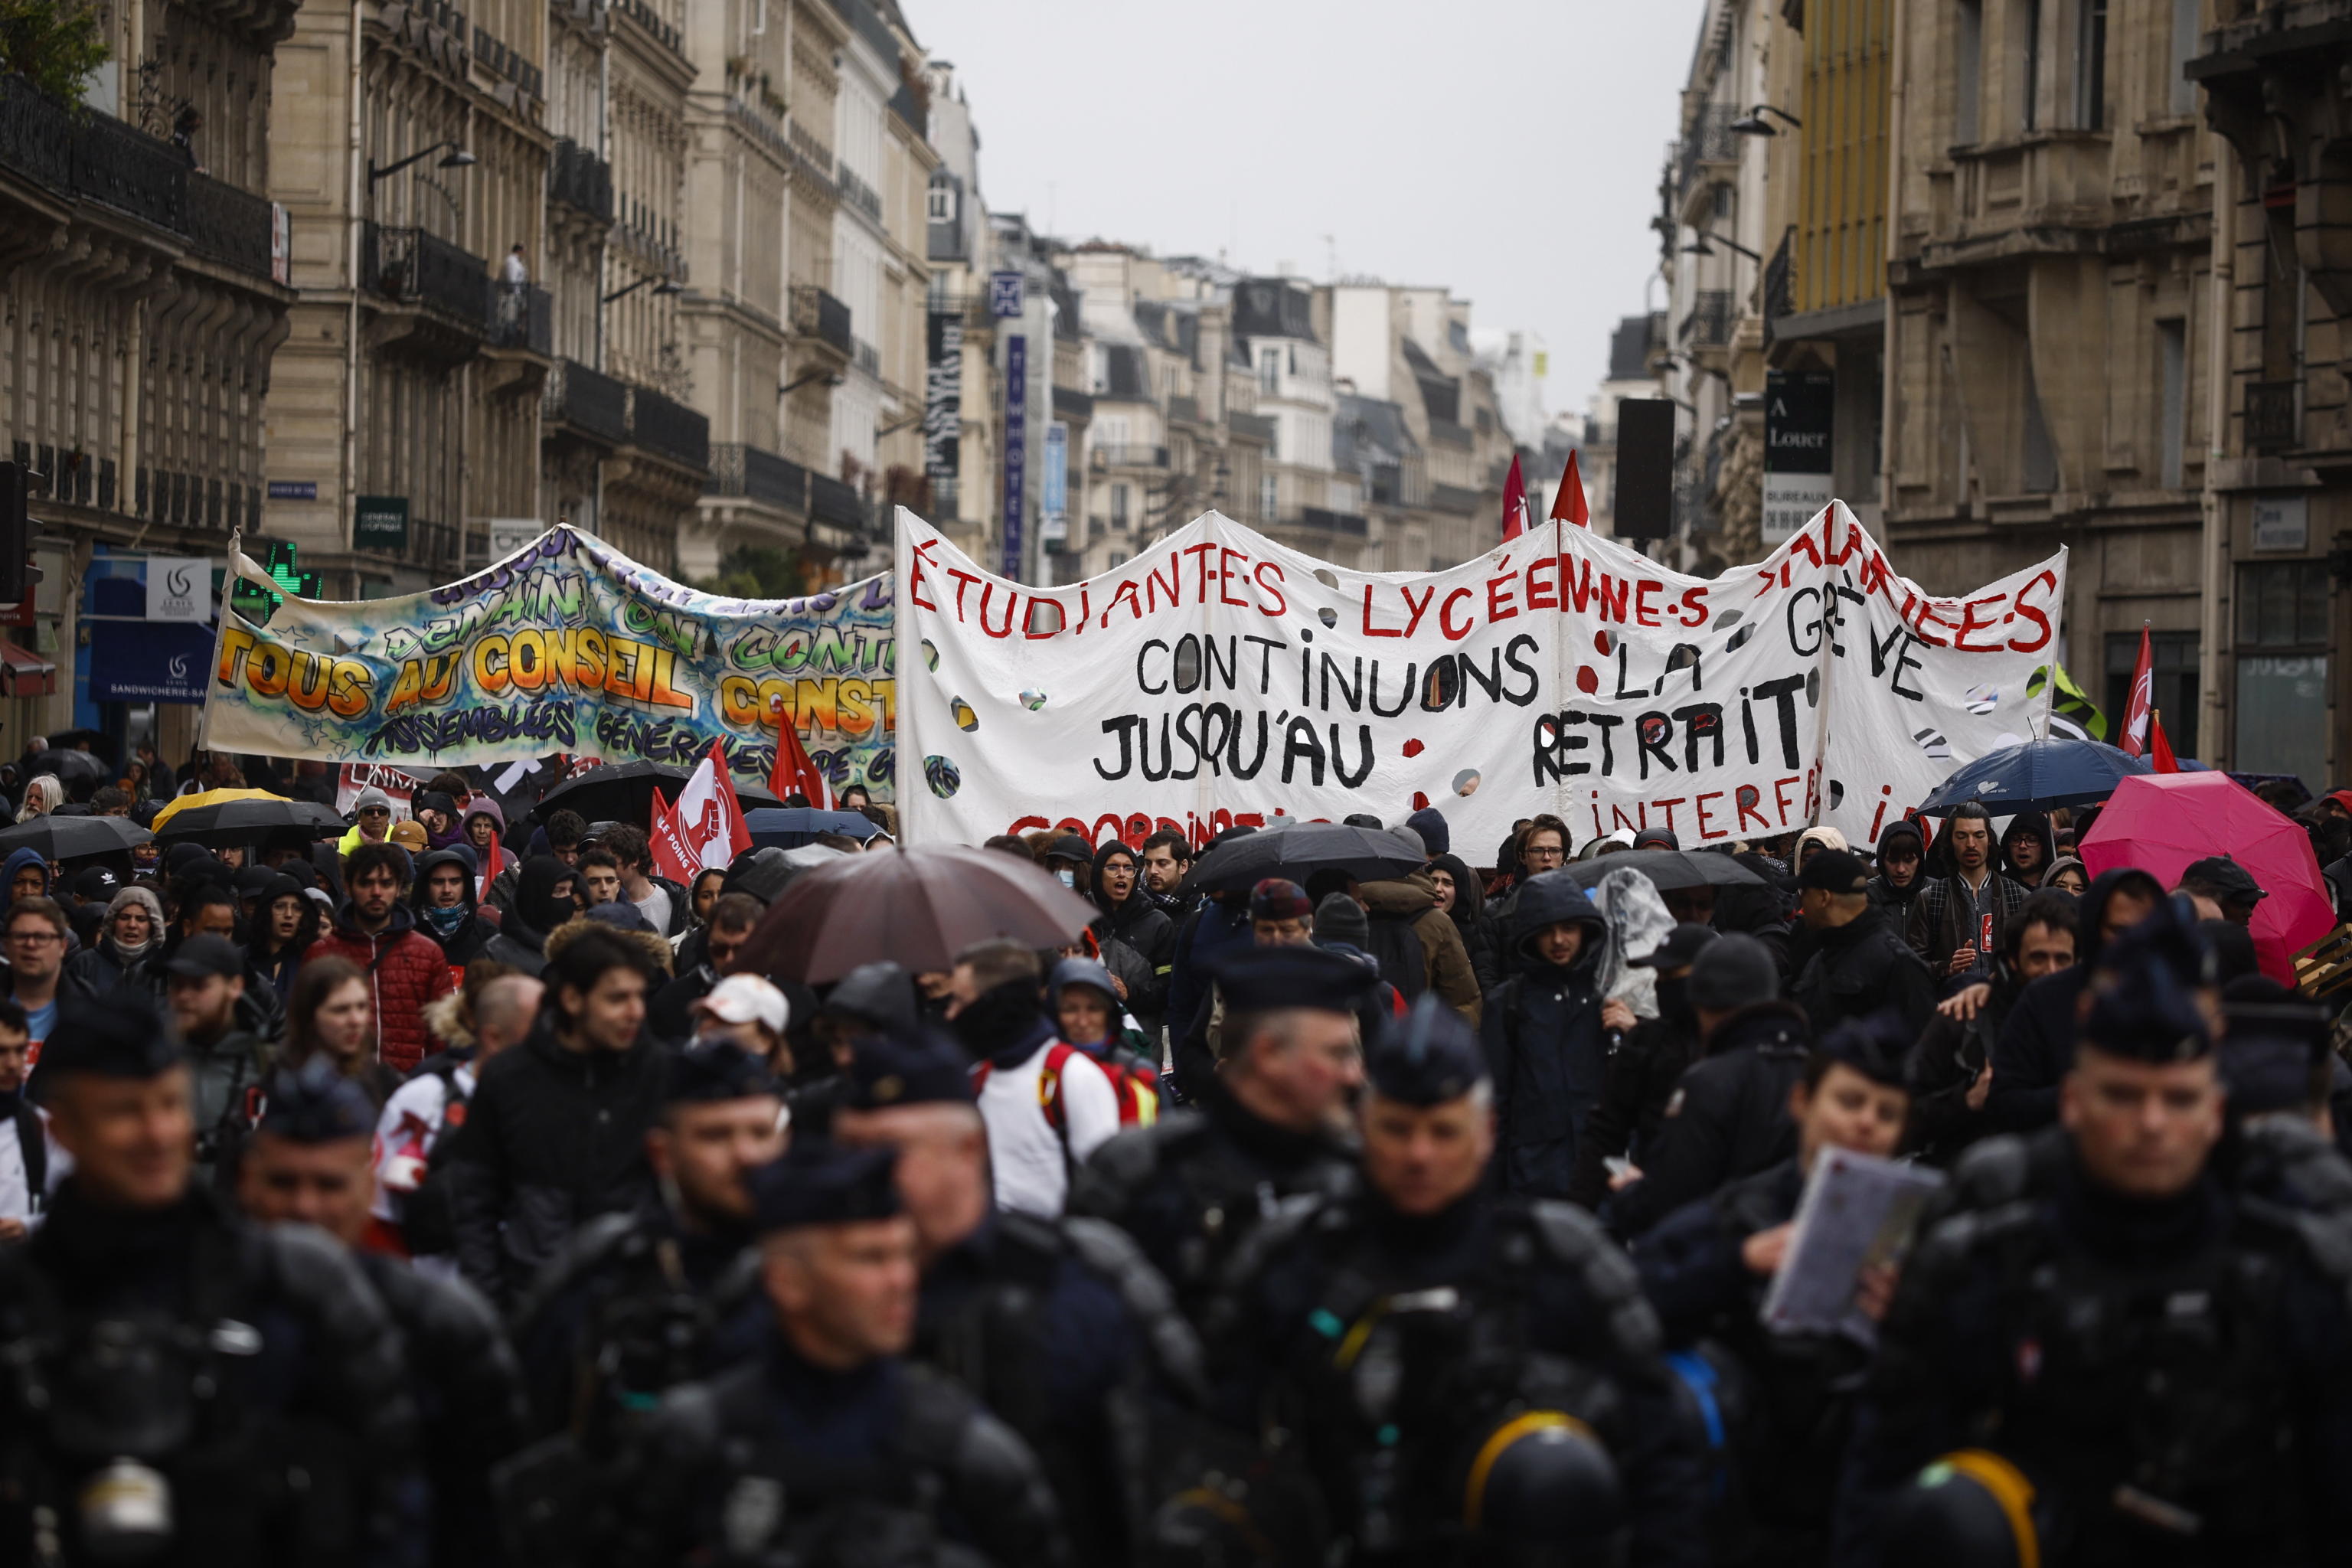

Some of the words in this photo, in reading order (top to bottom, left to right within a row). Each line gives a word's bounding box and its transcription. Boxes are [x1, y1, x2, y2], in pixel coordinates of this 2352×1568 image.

[1770, 426, 1828, 449] Louer
[1766, 490, 1828, 503] BUREAUX
[217, 626, 374, 721] TOUS
[385, 651, 462, 717] AU
[473, 627, 693, 717] CONSEIL
[1615, 642, 1701, 700] LA
[810, 745, 853, 784] DE
[1093, 701, 1375, 789] JUSQU'AU
[658, 820, 671, 834] LE
[667, 833, 690, 867] POING
